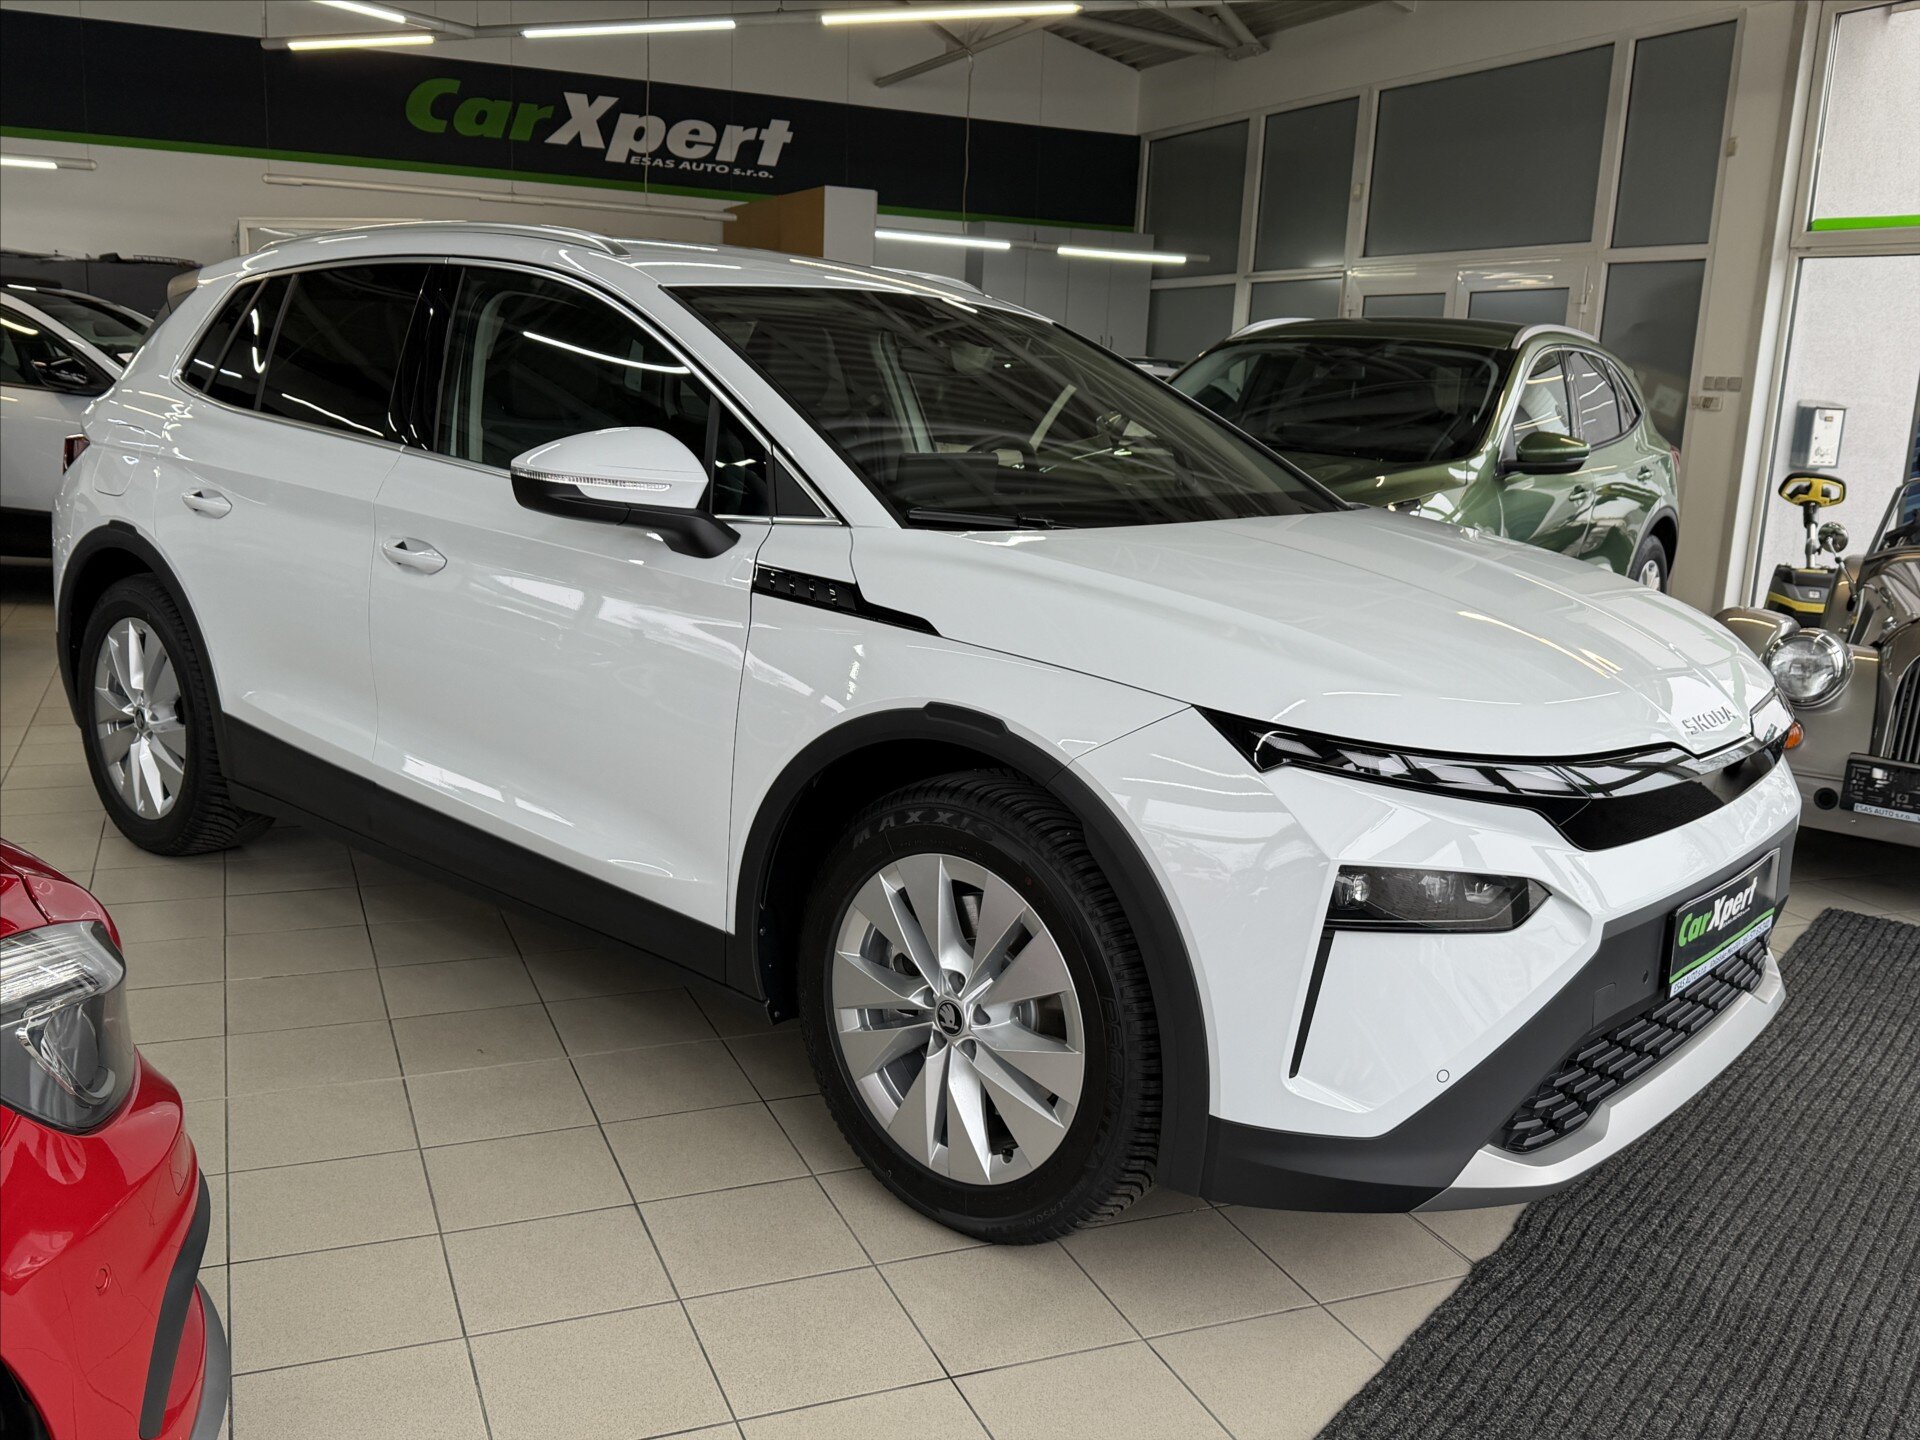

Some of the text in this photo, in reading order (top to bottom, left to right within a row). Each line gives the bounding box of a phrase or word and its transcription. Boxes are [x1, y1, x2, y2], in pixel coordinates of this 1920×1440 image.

[404, 77, 794, 167] CarXpert
[630, 156, 774, 179] ESAS AUTO s.r.o.
[1855, 804, 1873, 813] ESAS
[1874, 808, 1894, 817] AUTO
[1678, 875, 1758, 947] CarXpert
